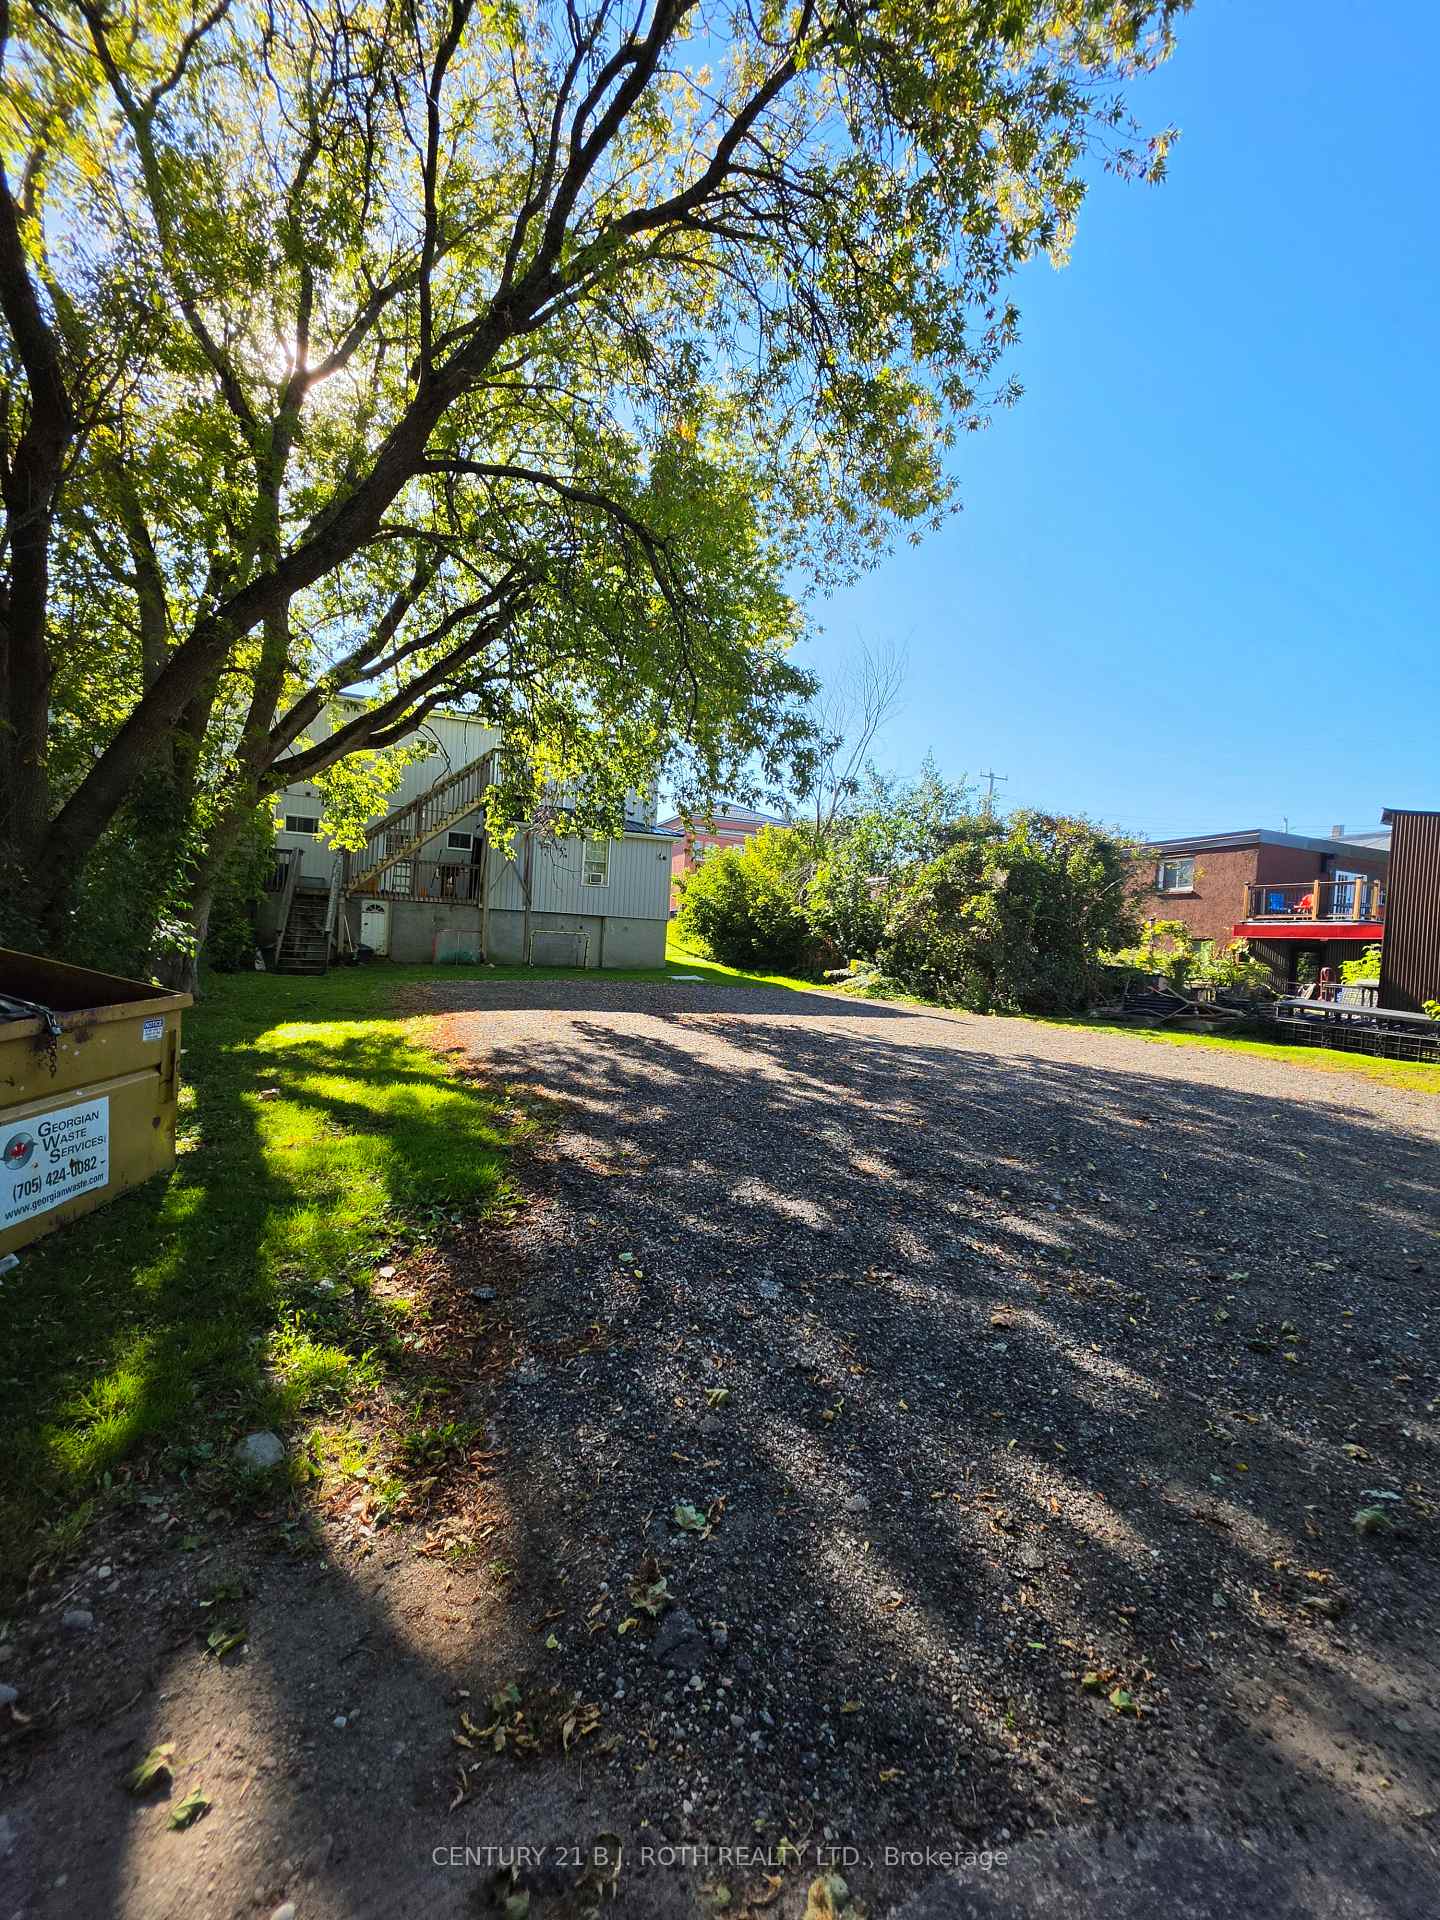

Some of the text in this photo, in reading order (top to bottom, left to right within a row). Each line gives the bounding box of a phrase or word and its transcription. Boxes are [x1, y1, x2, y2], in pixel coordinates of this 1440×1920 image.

[38, 1110, 100, 1137] GEORGIAN
[42, 1128, 87, 1151] WASTE
[49, 1136, 104, 1163] SERVICES
[4, 1173, 104, 1220] www.georgianwaste.com
[13, 1175, 42, 1202] (705)
